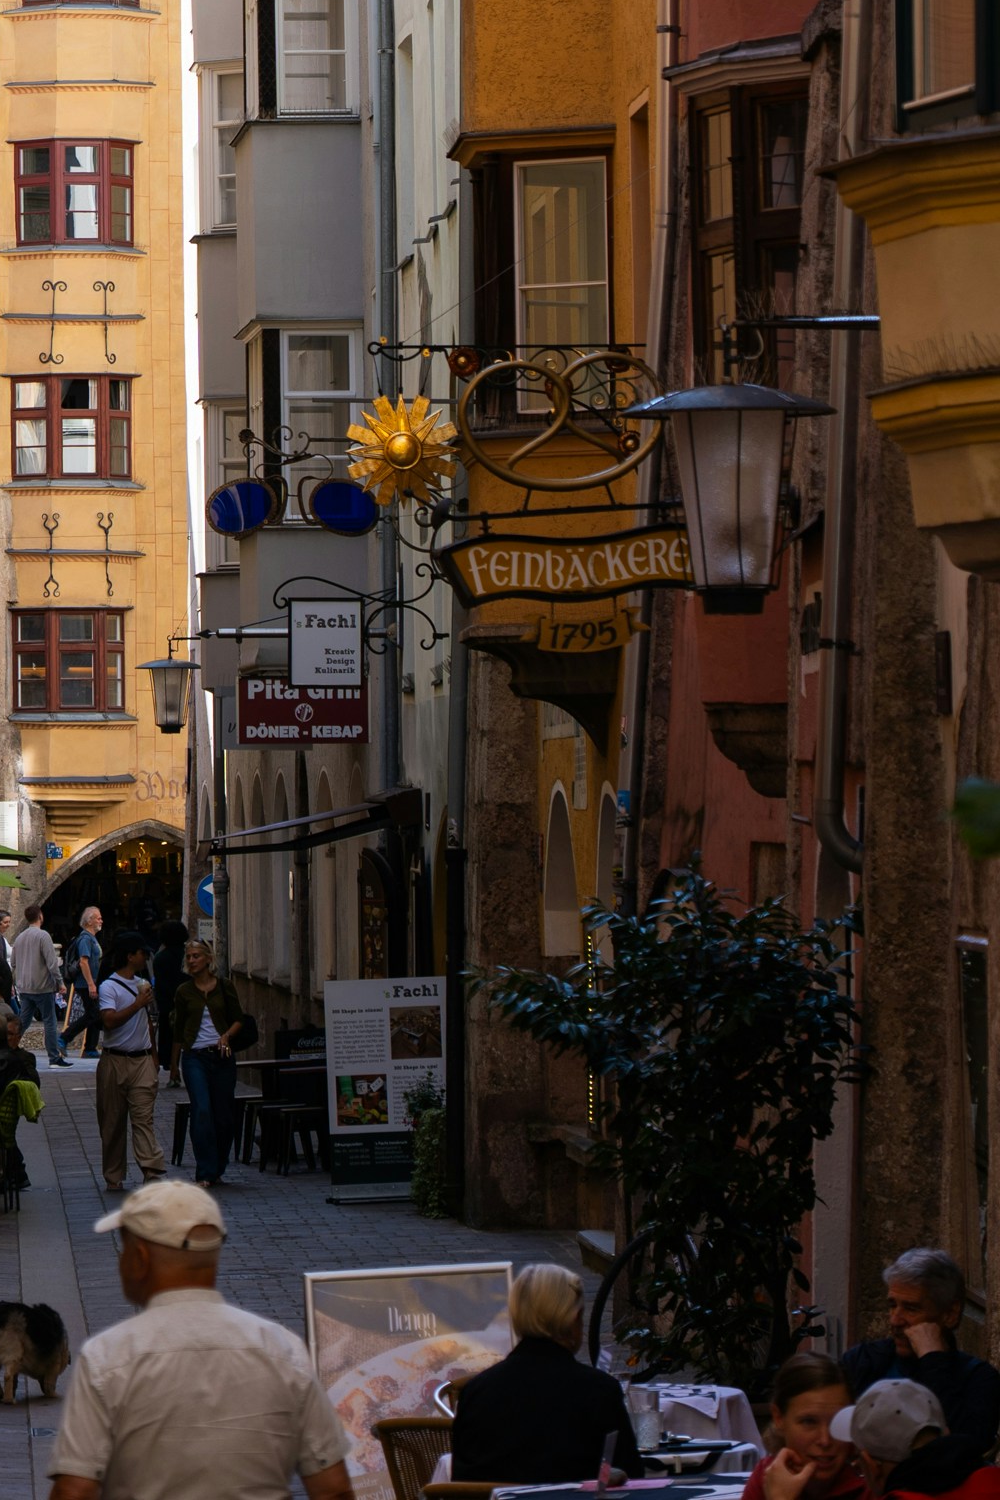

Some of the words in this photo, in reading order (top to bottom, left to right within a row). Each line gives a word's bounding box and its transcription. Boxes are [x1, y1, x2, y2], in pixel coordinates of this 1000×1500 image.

[468, 537, 695, 597] FEINBÄCKERE
[305, 614, 357, 628] Fachl
[549, 619, 617, 650] 1795
[326, 657, 355, 666] Design
[247, 679, 300, 700] Pita
[246, 722, 300, 738] DÖNER
[312, 725, 363, 738] KEBAP
[392, 984, 439, 998] Fachl
